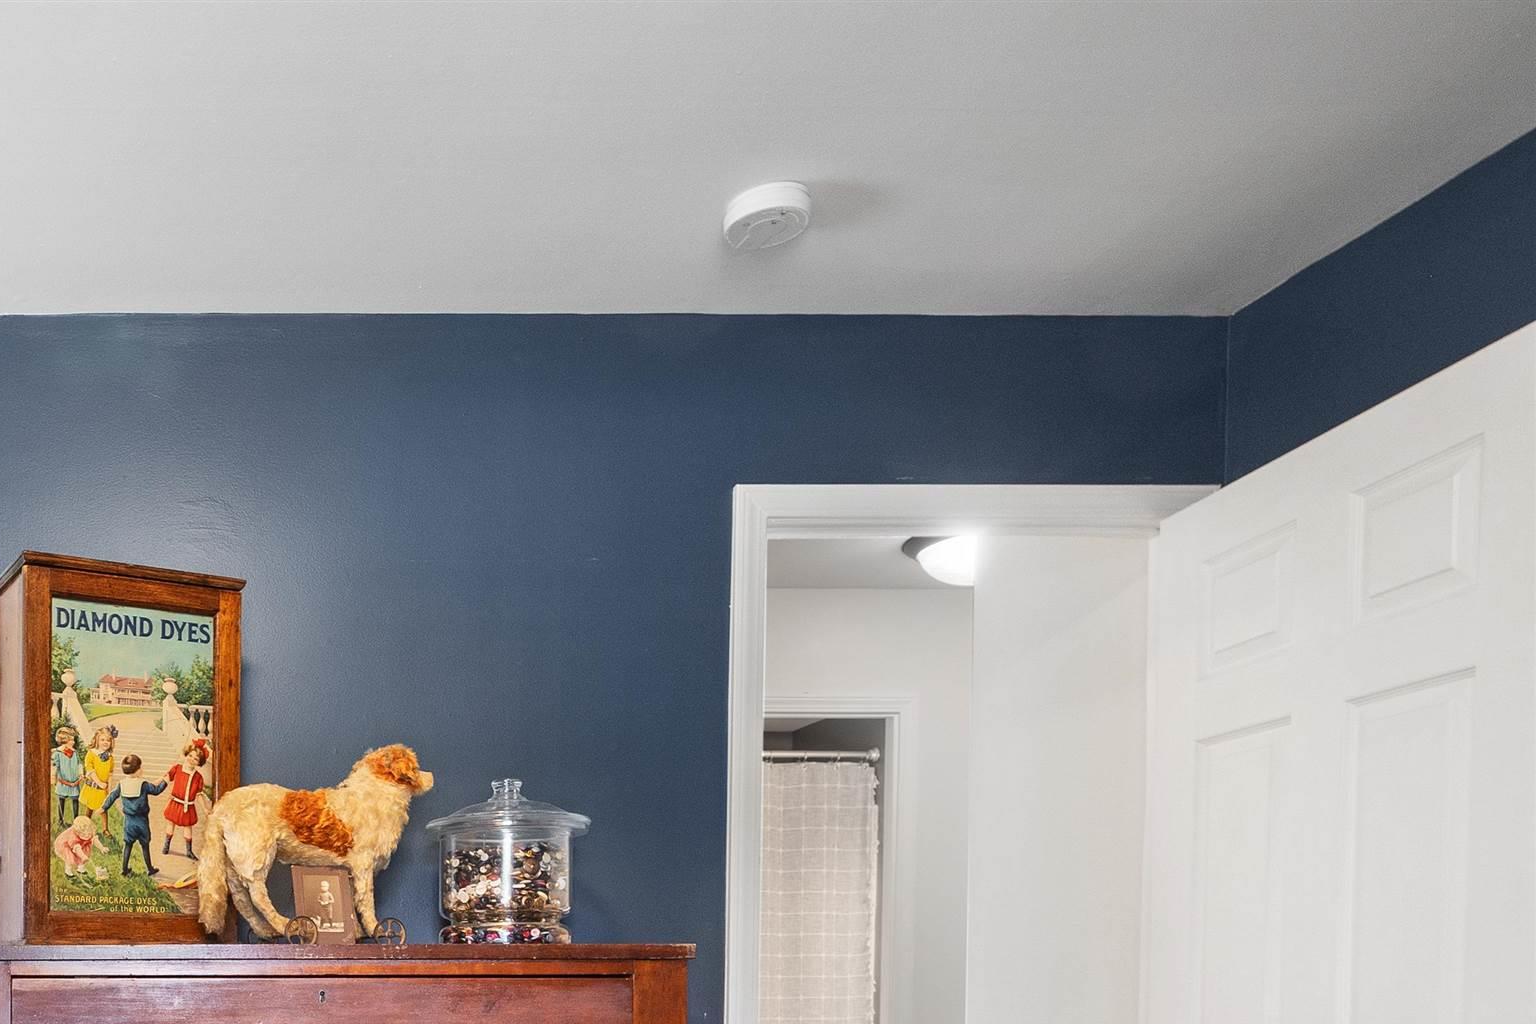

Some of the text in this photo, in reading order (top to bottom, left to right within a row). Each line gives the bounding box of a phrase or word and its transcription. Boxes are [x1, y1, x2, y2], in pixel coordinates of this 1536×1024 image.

[56, 606, 211, 644] DIAMOND DYES
[55, 895, 158, 906] STANDARD PACKAGE DYES
[120, 905, 133, 913] the
[136, 905, 165, 914] WORLD
